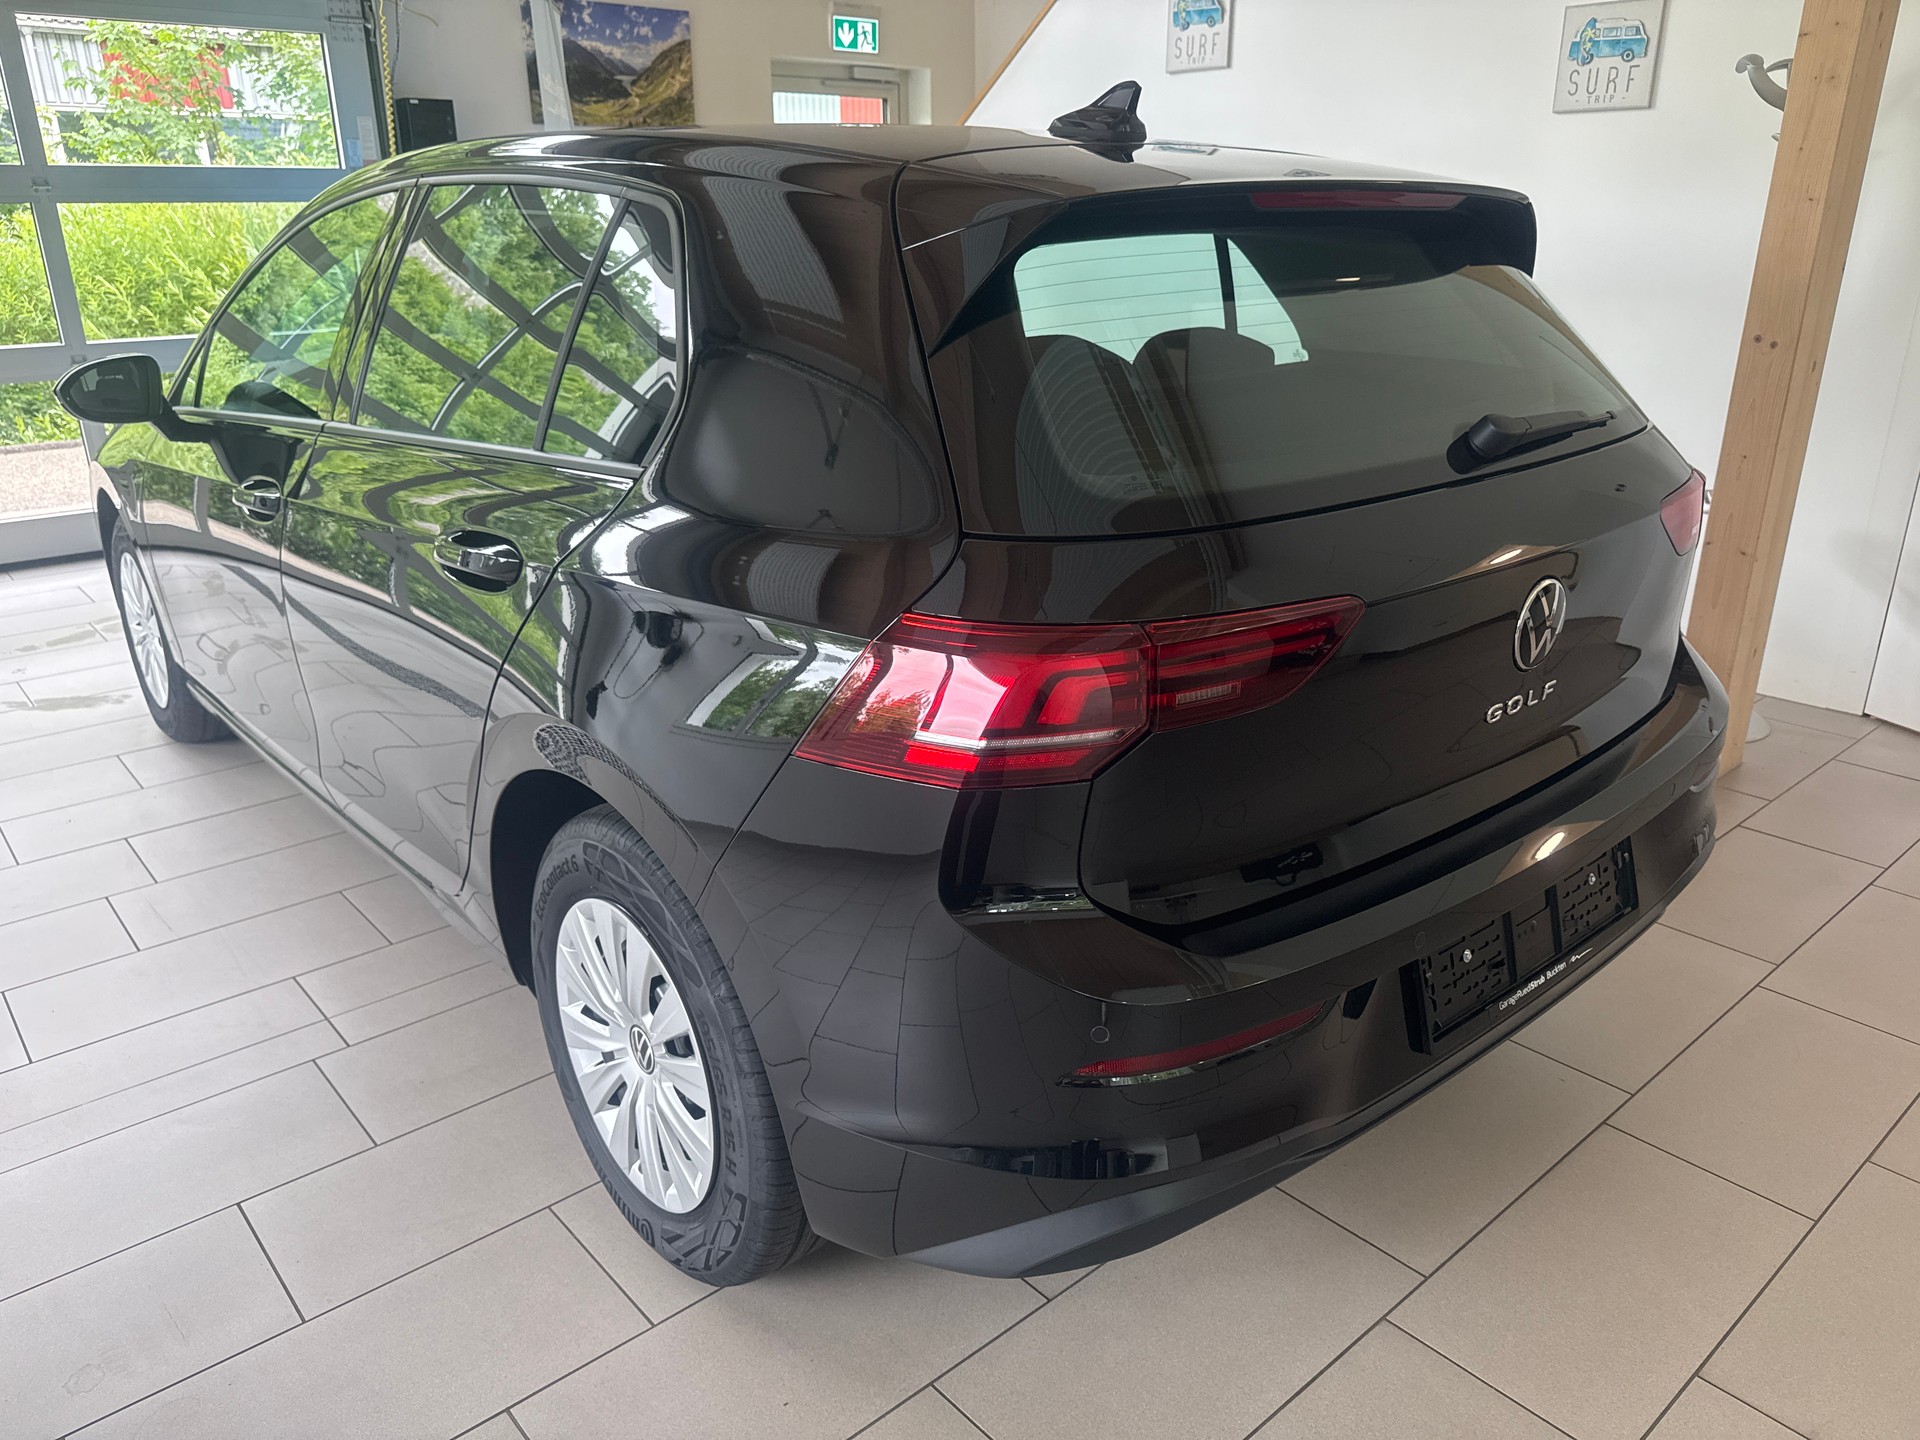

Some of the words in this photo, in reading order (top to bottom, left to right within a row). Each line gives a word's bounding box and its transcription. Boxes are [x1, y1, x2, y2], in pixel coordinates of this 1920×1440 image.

[1174, 32, 1220, 59] SURF
[1567, 64, 1640, 96] SURF
[1587, 95, 1615, 104] TRIP
[1486, 679, 1557, 724] GOLF
[534, 857, 573, 919] EcoContact
[570, 854, 581, 873] 6
[697, 1008, 729, 1097] 195/65
[720, 1106, 733, 1124] R
[724, 1129, 736, 1153] 15
[724, 1155, 737, 1177] H
